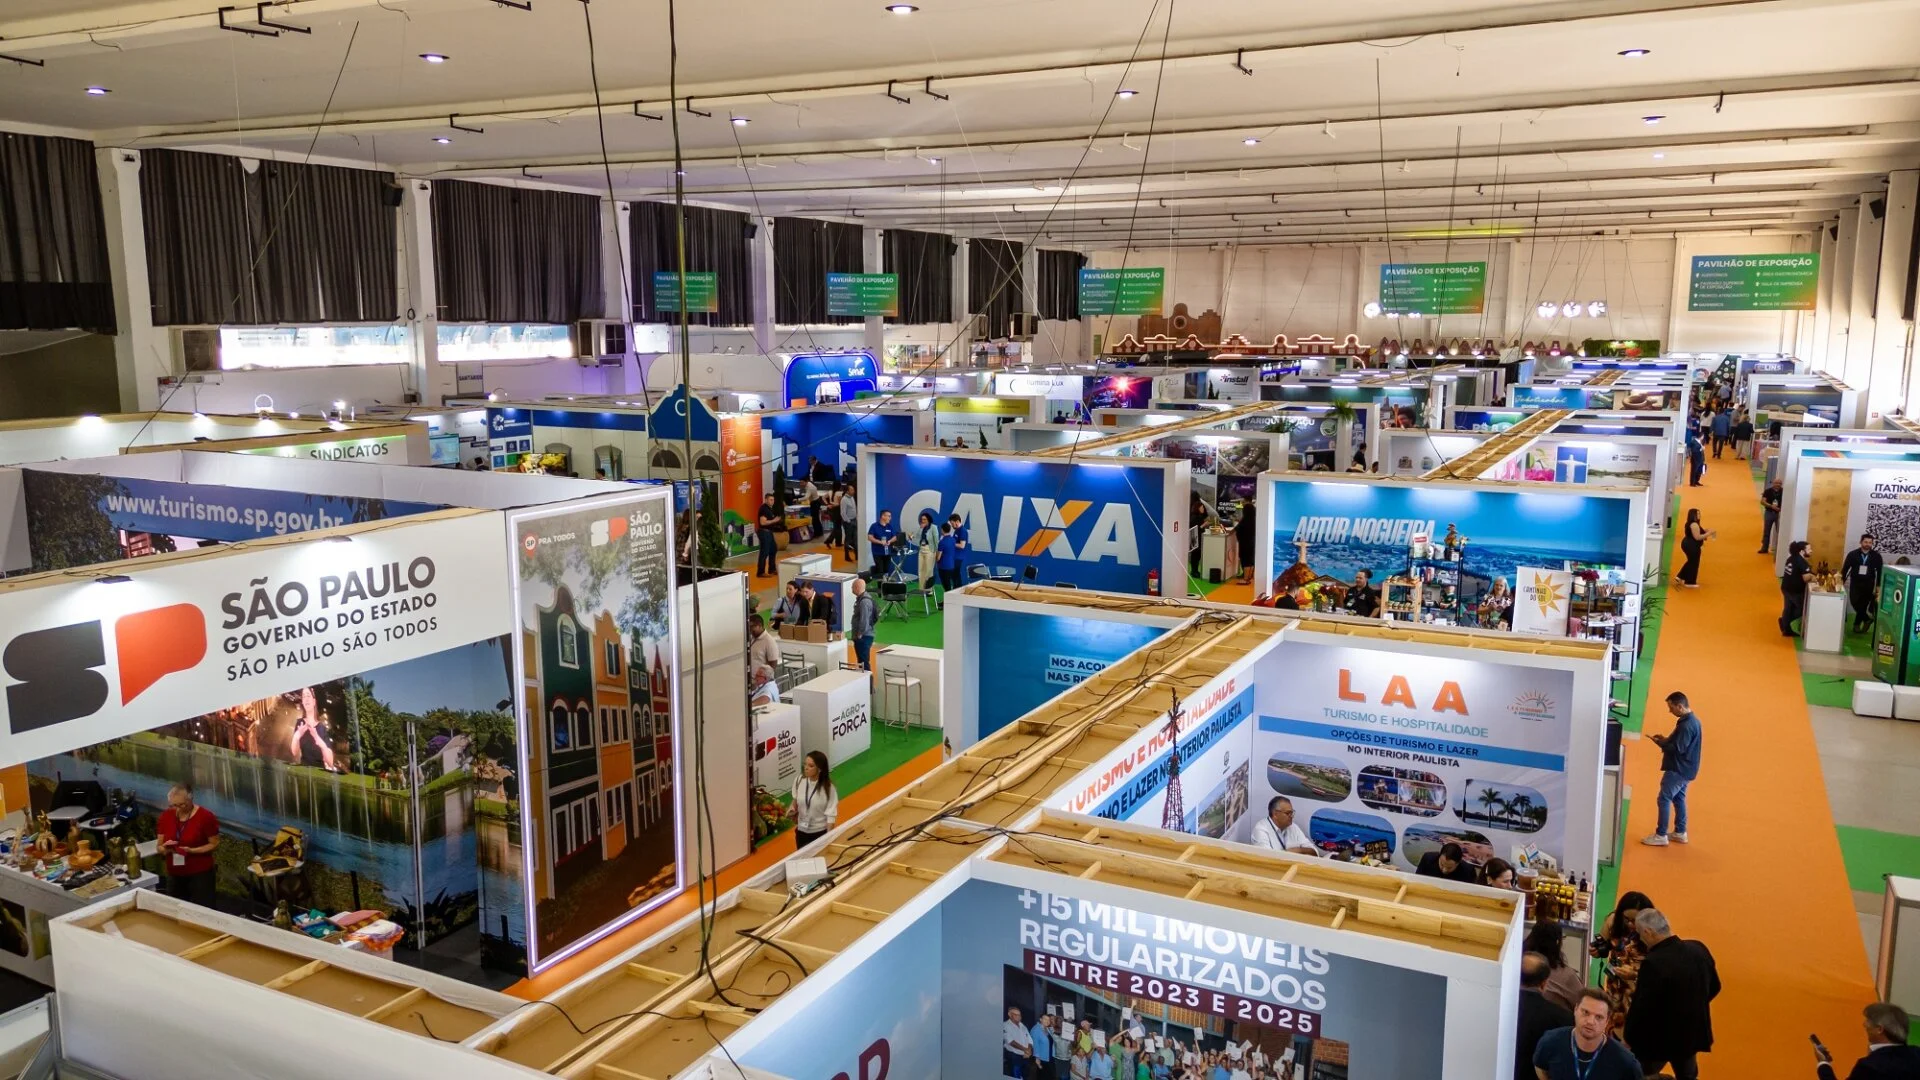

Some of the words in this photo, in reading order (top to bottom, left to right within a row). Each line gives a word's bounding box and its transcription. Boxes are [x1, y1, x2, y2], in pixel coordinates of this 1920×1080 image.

[1386, 267, 1423, 275] PAVILHÃO
[1436, 266, 1480, 275] EXPOSIÇÃO
[1698, 259, 1744, 267] PAVILHÃO
[1759, 257, 1813, 268] EXPOSIÇÃO
[1124, 272, 1160, 280] EXPOSIÇÃO
[1224, 375, 1249, 383] install
[310, 443, 389, 461] SINDICATOS
[1870, 492, 1898, 500] CIDADE
[106, 493, 344, 534] www.turismo.sp.gov.br
[630, 510, 651, 526] SÃO
[631, 523, 662, 540] PAULO
[901, 490, 1141, 566] CAIXA
[1293, 516, 1351, 543] ARTUR
[538, 537, 552, 546] PRA
[553, 533, 576, 542] TODOS
[221, 576, 309, 630] SÃO
[318, 556, 436, 609] PAULO
[223, 617, 330, 654] GOVERNO
[337, 608, 365, 629] DO
[371, 592, 438, 622] ESTADO
[227, 654, 269, 682] SÃO
[276, 641, 335, 669] PAULO
[343, 630, 377, 654] SÃO
[384, 616, 439, 642] TODOS
[1051, 657, 1075, 668] NOS
[1047, 671, 1070, 682] NAS
[840, 704, 861, 720] AGRO
[1323, 707, 1377, 724] TURISMO
[1380, 715, 1388, 725] E
[1391, 716, 1489, 738] HOSPITALIDADE
[778, 730, 790, 742] SÃO
[832, 712, 868, 741] FORÇA
[778, 736, 797, 750] PAULO
[1331, 728, 1372, 742] OPÇÕES
[1374, 734, 1387, 744] DE
[1389, 737, 1436, 750] TURISMO
[1438, 743, 1444, 751] E
[1446, 744, 1479, 757] LAZER
[1121, 791, 1128, 814] E
[1129, 769, 1158, 807] LAZER
[1174, 731, 1210, 766] NTERIOR
[1210, 701, 1242, 741] PAULISTA
[1347, 744, 1362, 754] NO
[1364, 746, 1410, 761] INTERIOR
[1412, 752, 1460, 768] PAULISTA
[1018, 889, 1072, 921] +15
[1079, 900, 1147, 939] MIL
[1020, 918, 1327, 1011] REGULARIZADOS
[1034, 954, 1119, 990] ENTRE
[1130, 975, 1199, 1008] 2023
[1213, 994, 1225, 1015] E
[1237, 1000, 1313, 1034] 2025
